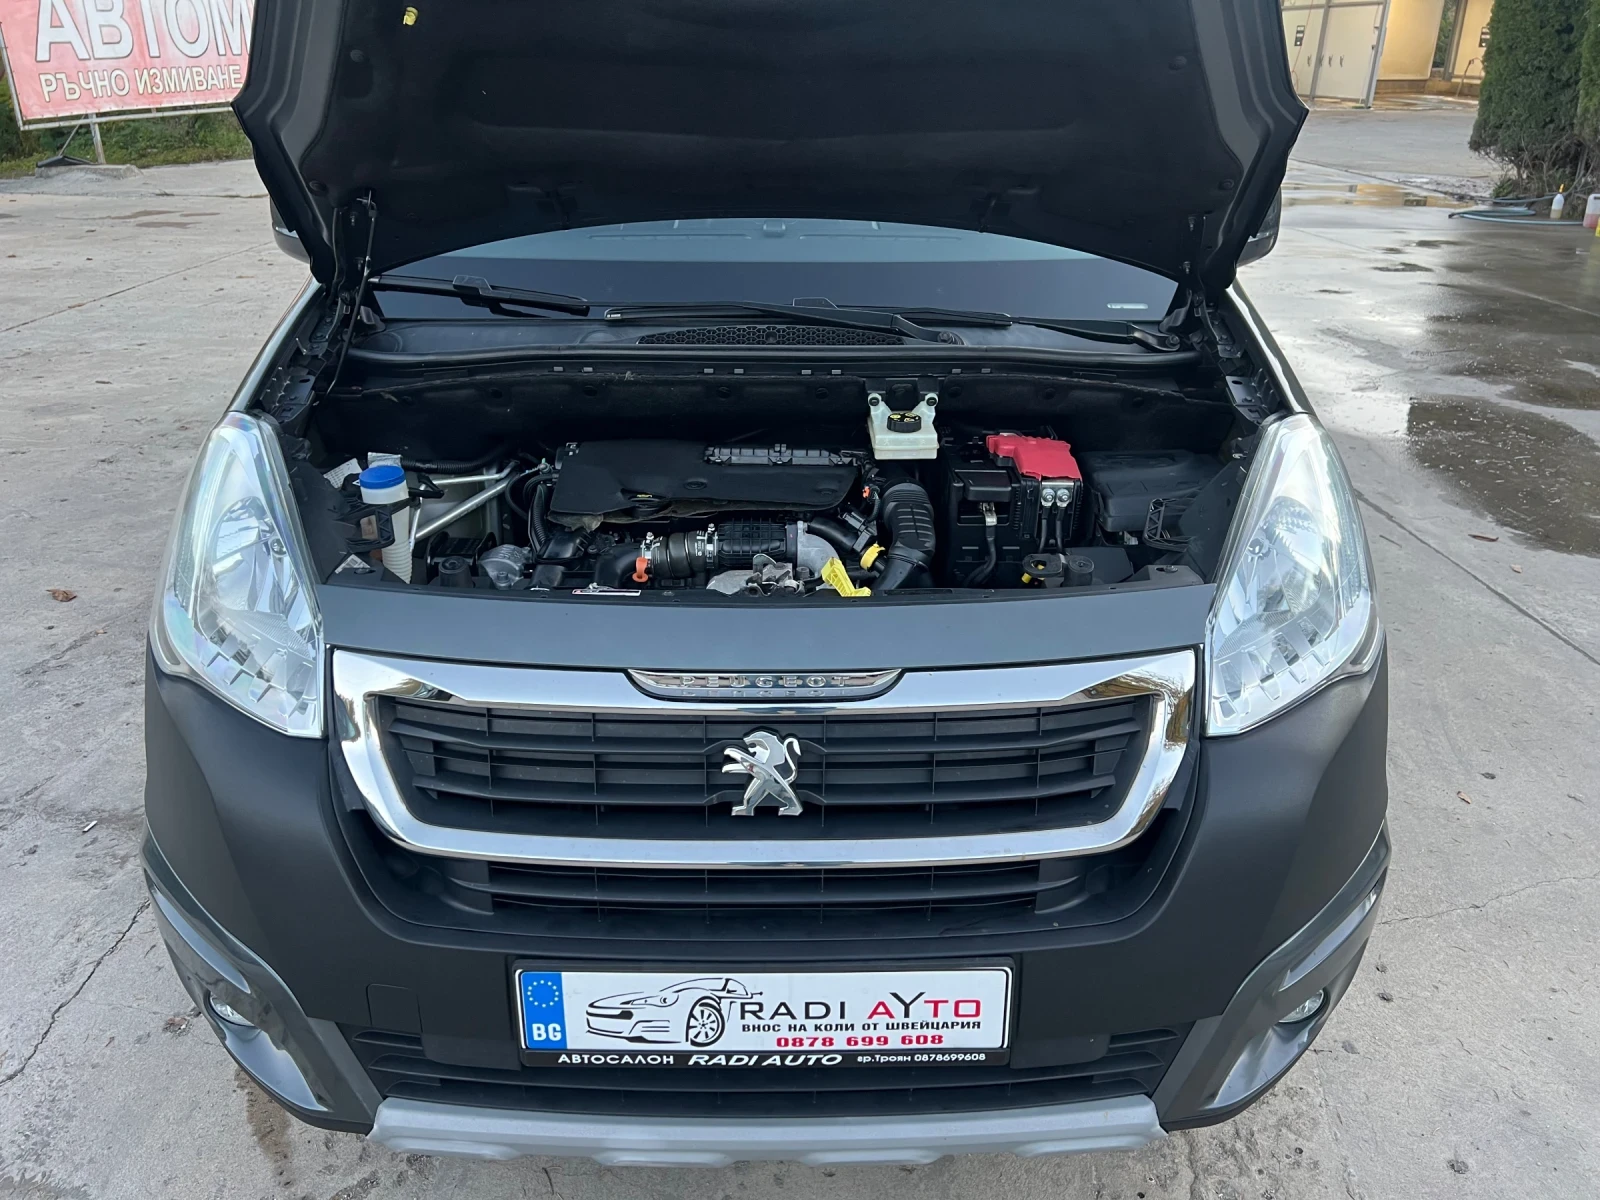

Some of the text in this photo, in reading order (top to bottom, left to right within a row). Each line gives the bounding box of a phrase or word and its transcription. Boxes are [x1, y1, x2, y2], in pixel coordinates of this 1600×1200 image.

[38, 64, 244, 103] РЪЧНО ИЗМИВАНЕ
[680, 674, 850, 688] PEUGEOT
[740, 1001, 846, 1020] RADI
[532, 1023, 562, 1041] BG
[742, 1020, 981, 1033] ВНОС НА КОЛИ ОТ ШВЕЙЦАРИЯ
[776, 1034, 944, 1048] 0878 699 608
[557, 1053, 674, 1065] АВТОСАЛОН
[688, 1054, 843, 1066] RADI AUTO
[914, 1053, 986, 1062] 0878699608
